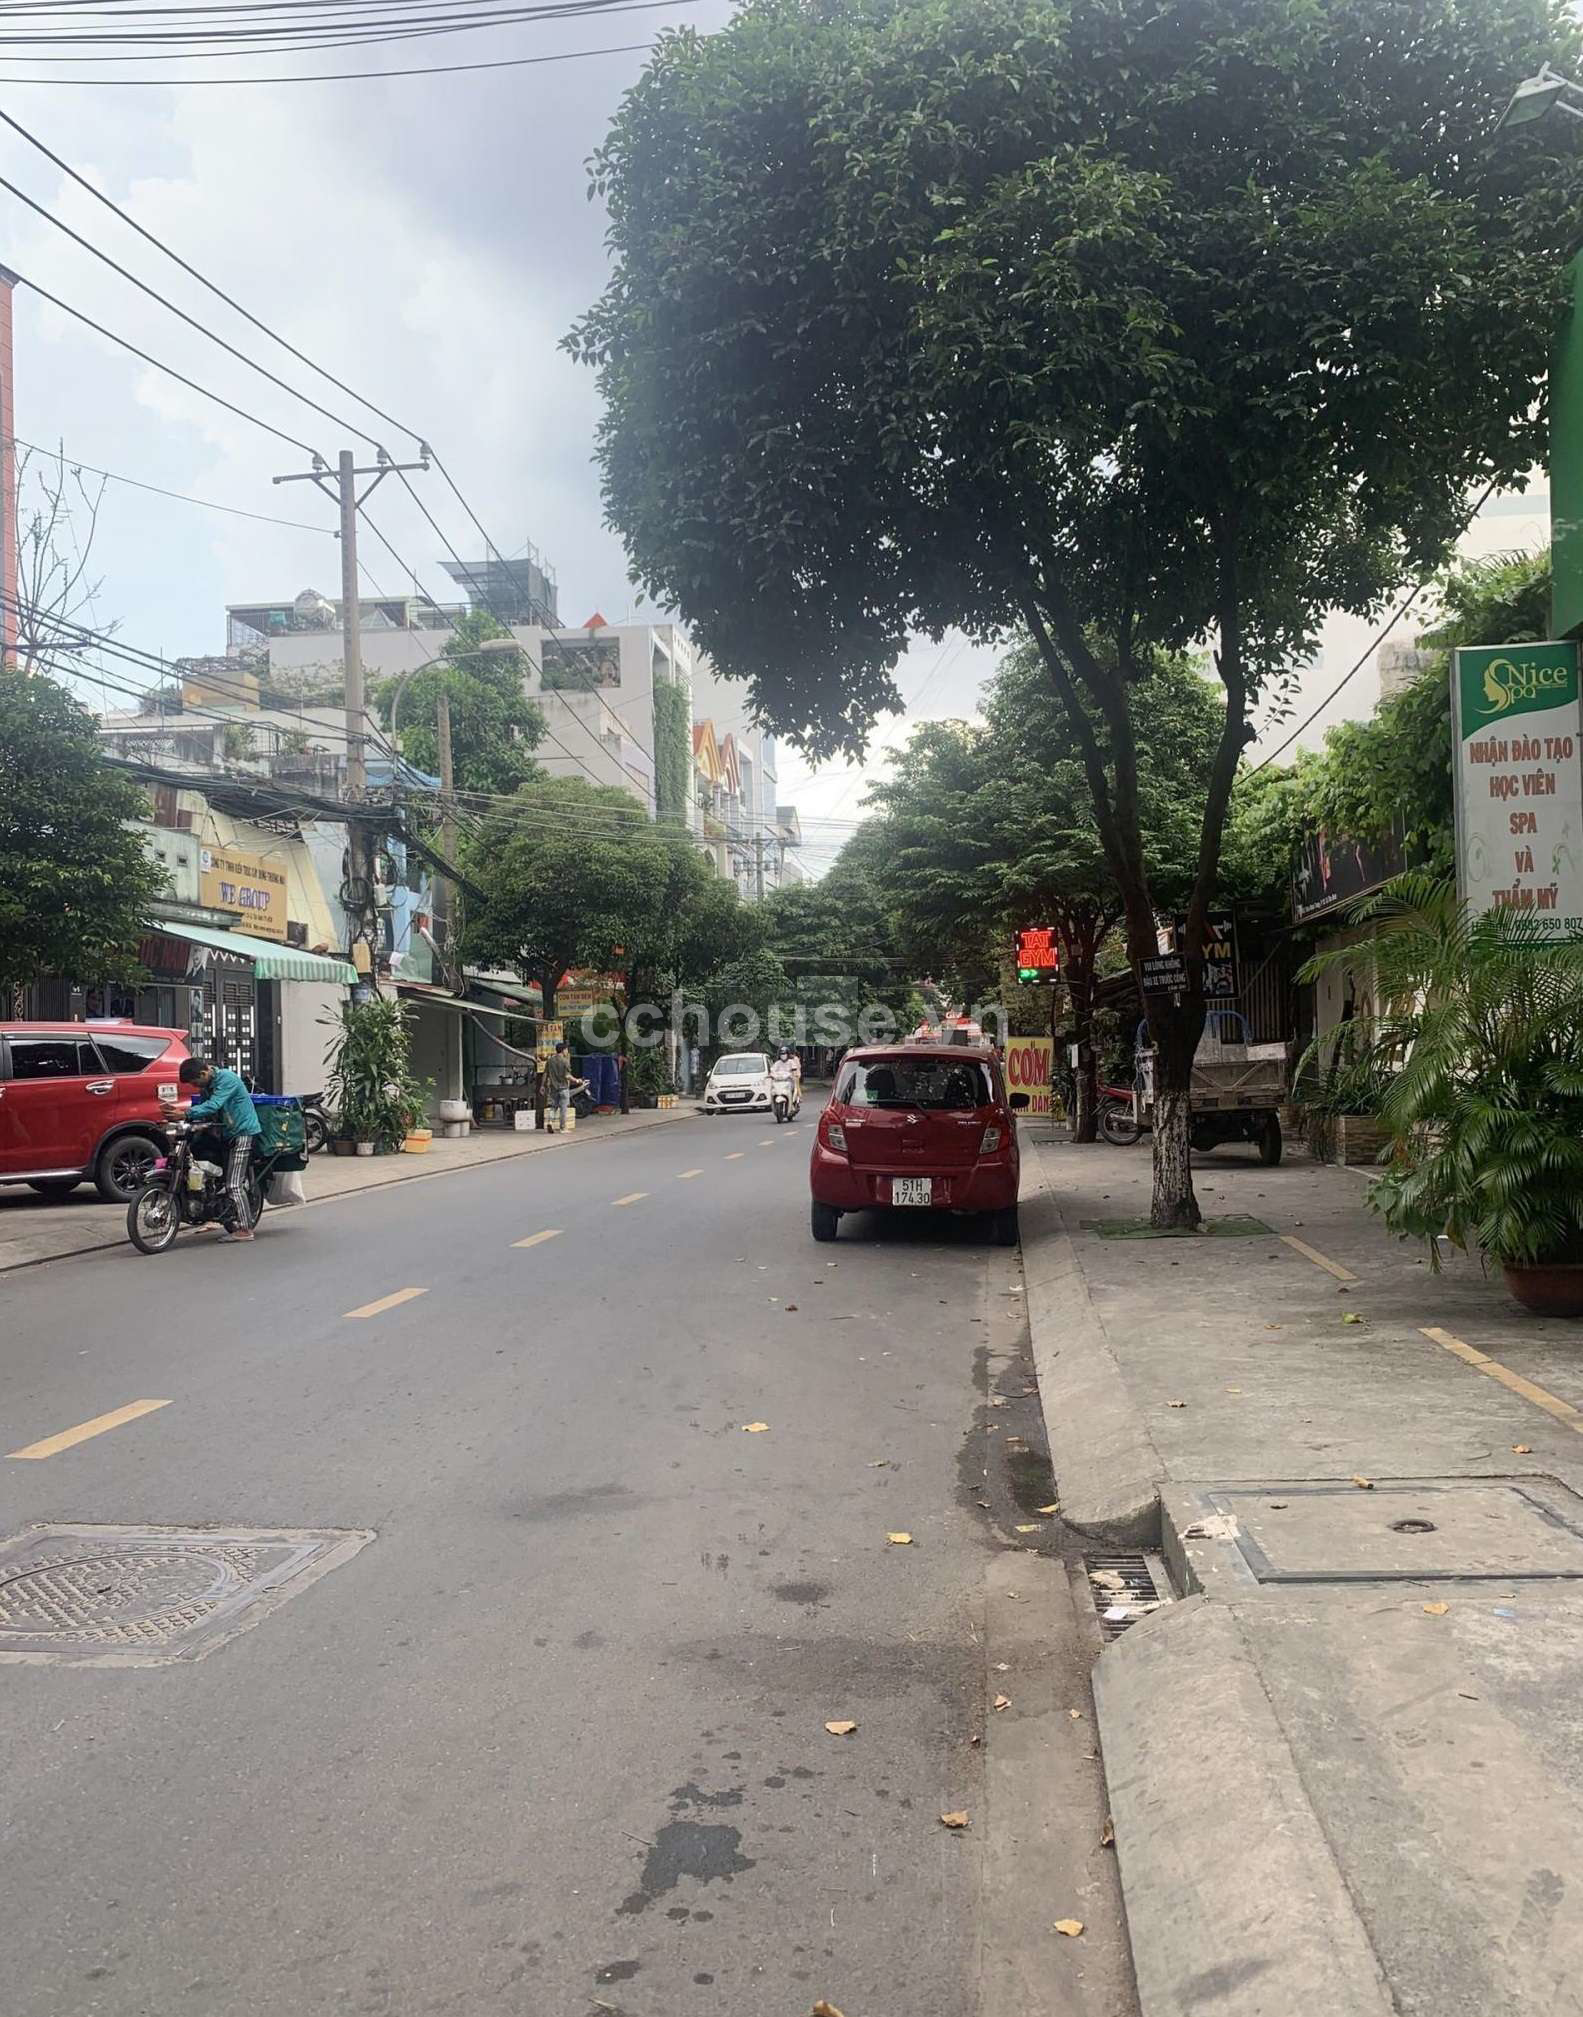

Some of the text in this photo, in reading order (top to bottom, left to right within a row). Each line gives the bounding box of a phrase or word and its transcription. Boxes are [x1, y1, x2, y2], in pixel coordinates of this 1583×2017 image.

[1504, 661, 1568, 686] Nice
[1469, 733, 1573, 767] NHẬN ĐÀO TẠO
[1489, 768, 1556, 801] HỌC VIÊN
[1509, 812, 1537, 834] SPA
[1514, 845, 1534, 873] VÀ
[239, 886, 271, 912] GROUP
[1537, 882, 1558, 909] MỸ
[1542, 918, 1561, 930] 650
[1021, 931, 1052, 949] TAT
[1020, 948, 1056, 967] GYM
[1008, 1040, 1050, 1088] CƠM
[895, 1192, 930, 1204] 174.30
[902, 1179, 923, 1192] 51H
